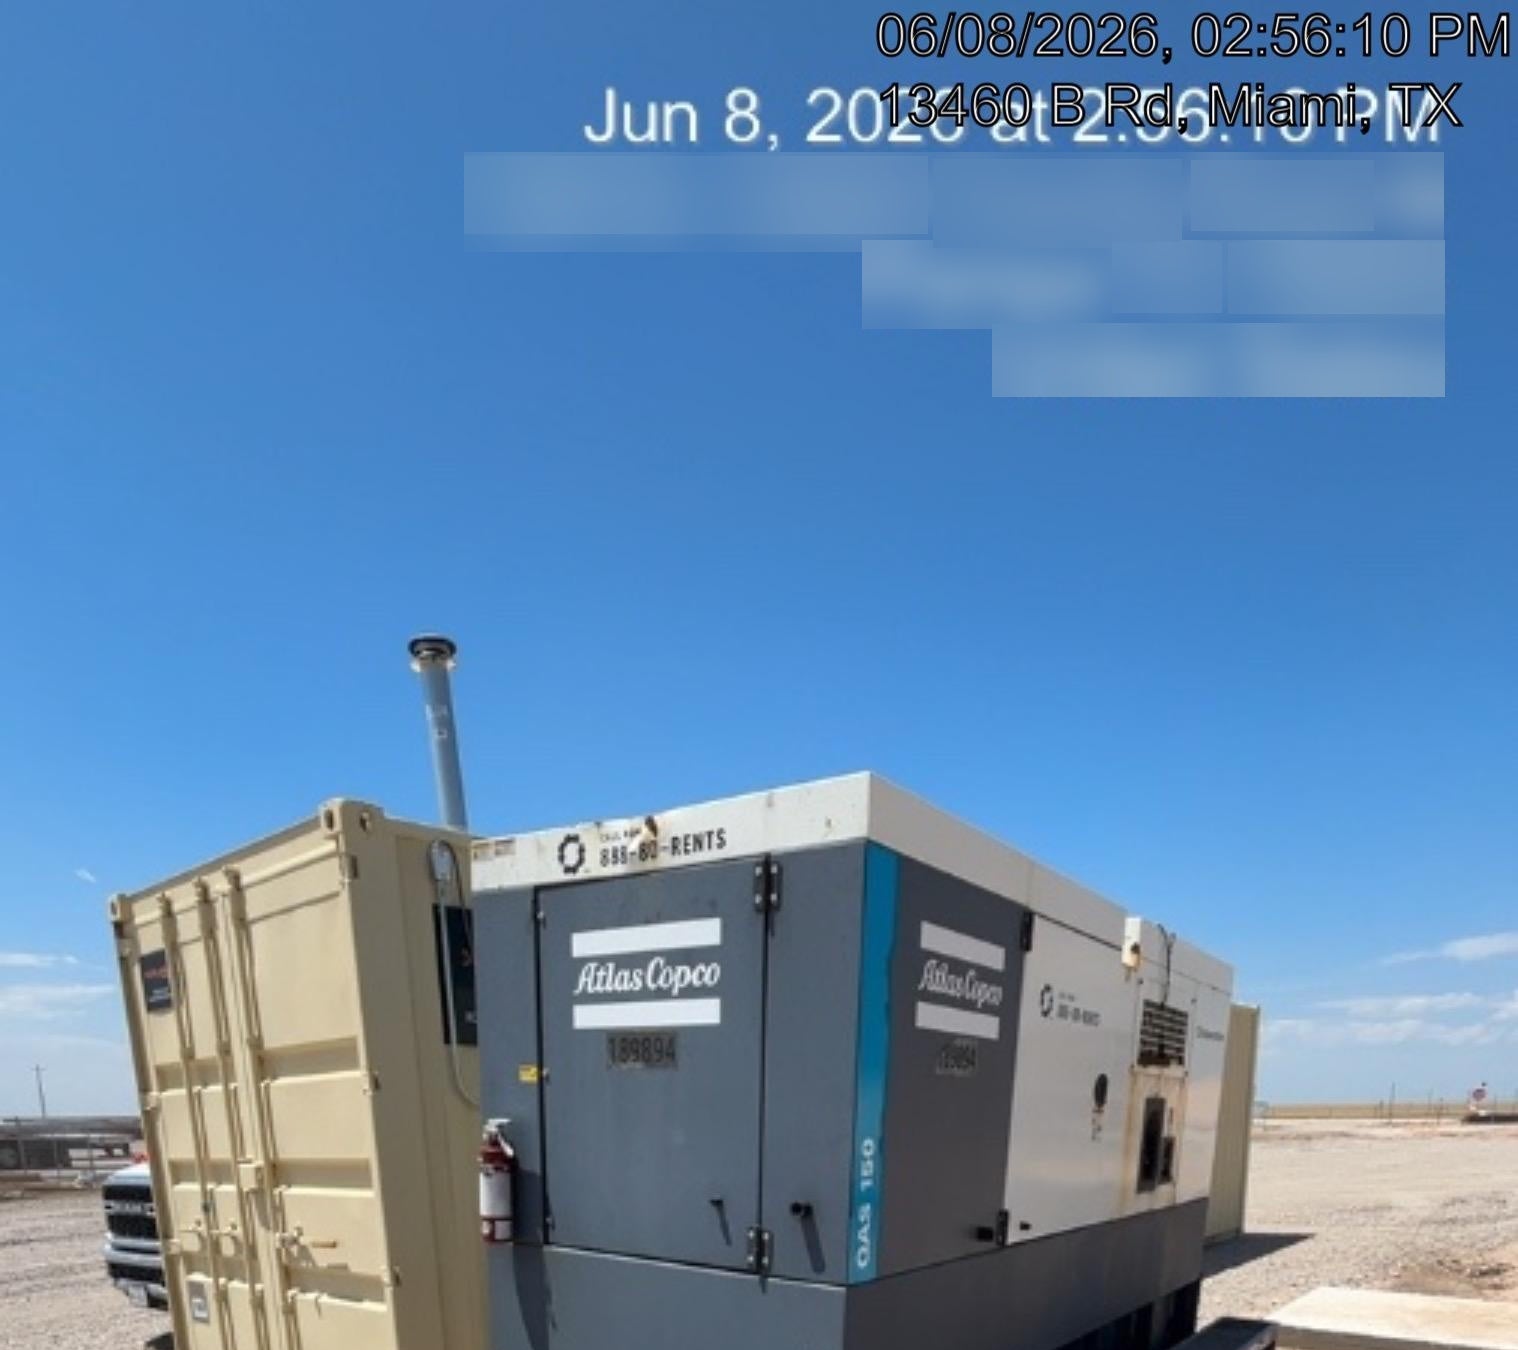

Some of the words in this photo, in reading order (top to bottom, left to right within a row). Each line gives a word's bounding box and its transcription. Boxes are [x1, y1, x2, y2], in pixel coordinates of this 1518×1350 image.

[572, 961, 643, 996] Atlas
[645, 956, 721, 996] Copco
[917, 959, 964, 999] Atlas
[607, 1035, 677, 1065] 189894
[860, 1137, 875, 1192] 150
[857, 1203, 872, 1269] QAS
